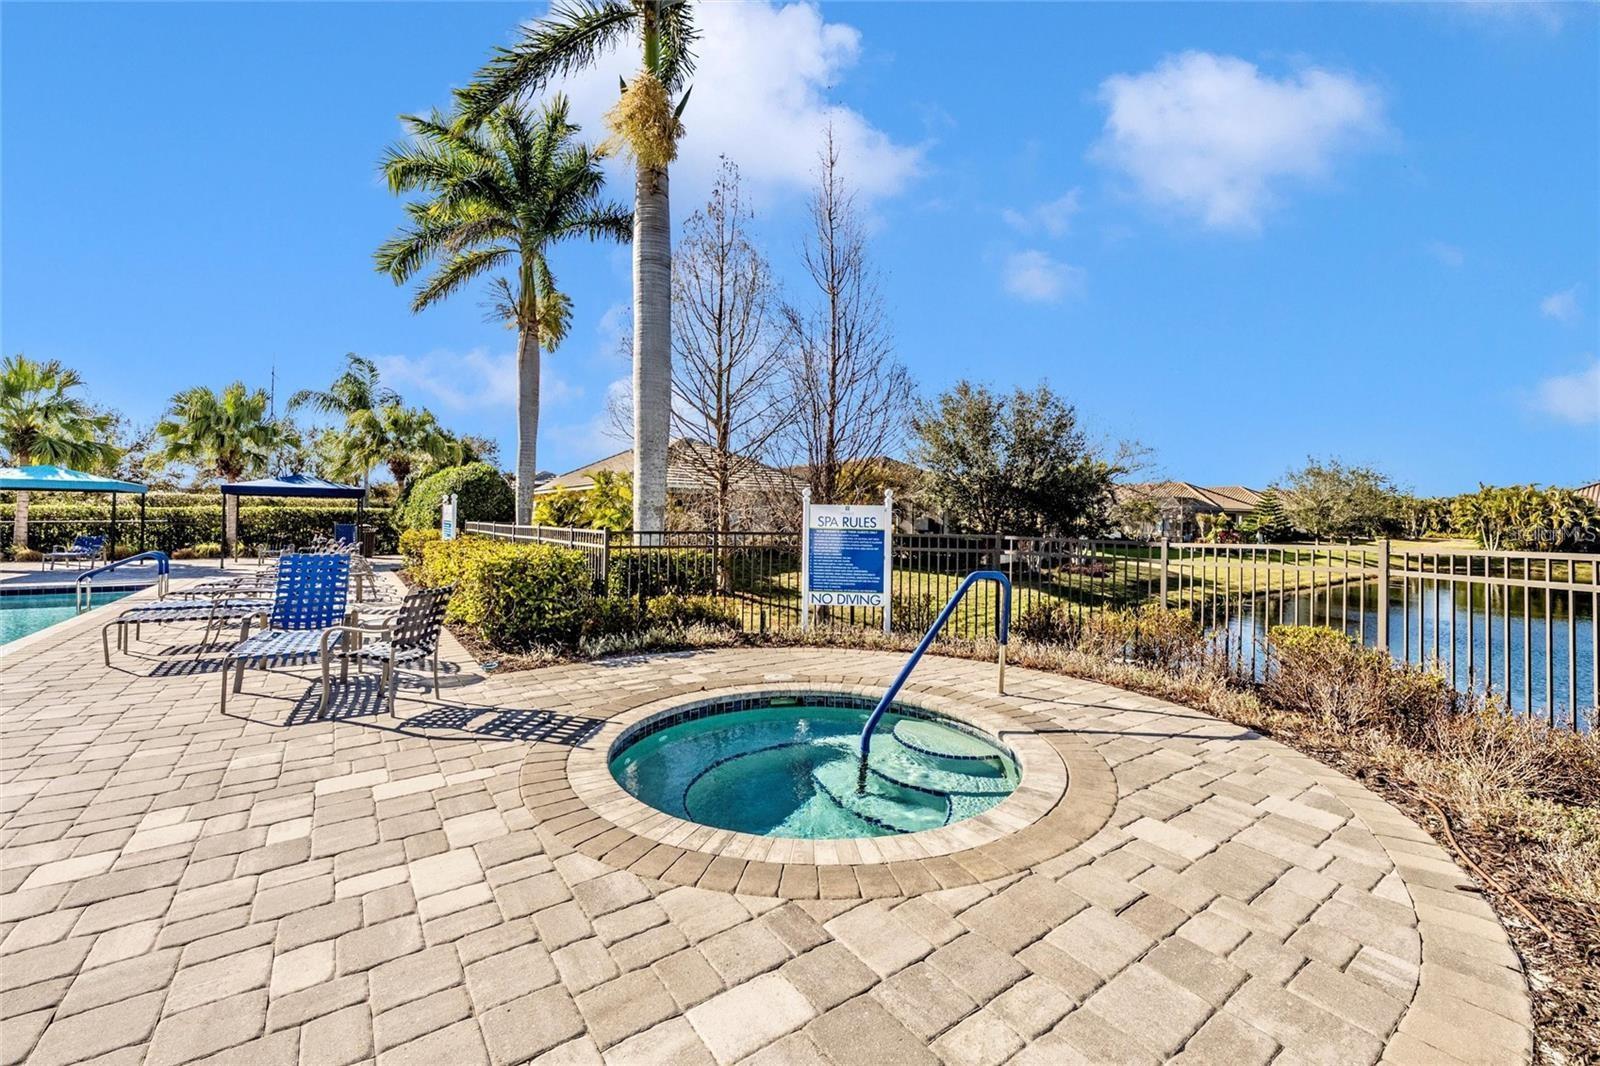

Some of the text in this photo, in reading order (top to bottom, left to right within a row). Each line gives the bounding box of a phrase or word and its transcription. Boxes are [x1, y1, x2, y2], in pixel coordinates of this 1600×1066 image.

[818, 516, 877, 528] SPA RULES
[811, 593, 881, 605] NO DIVING
